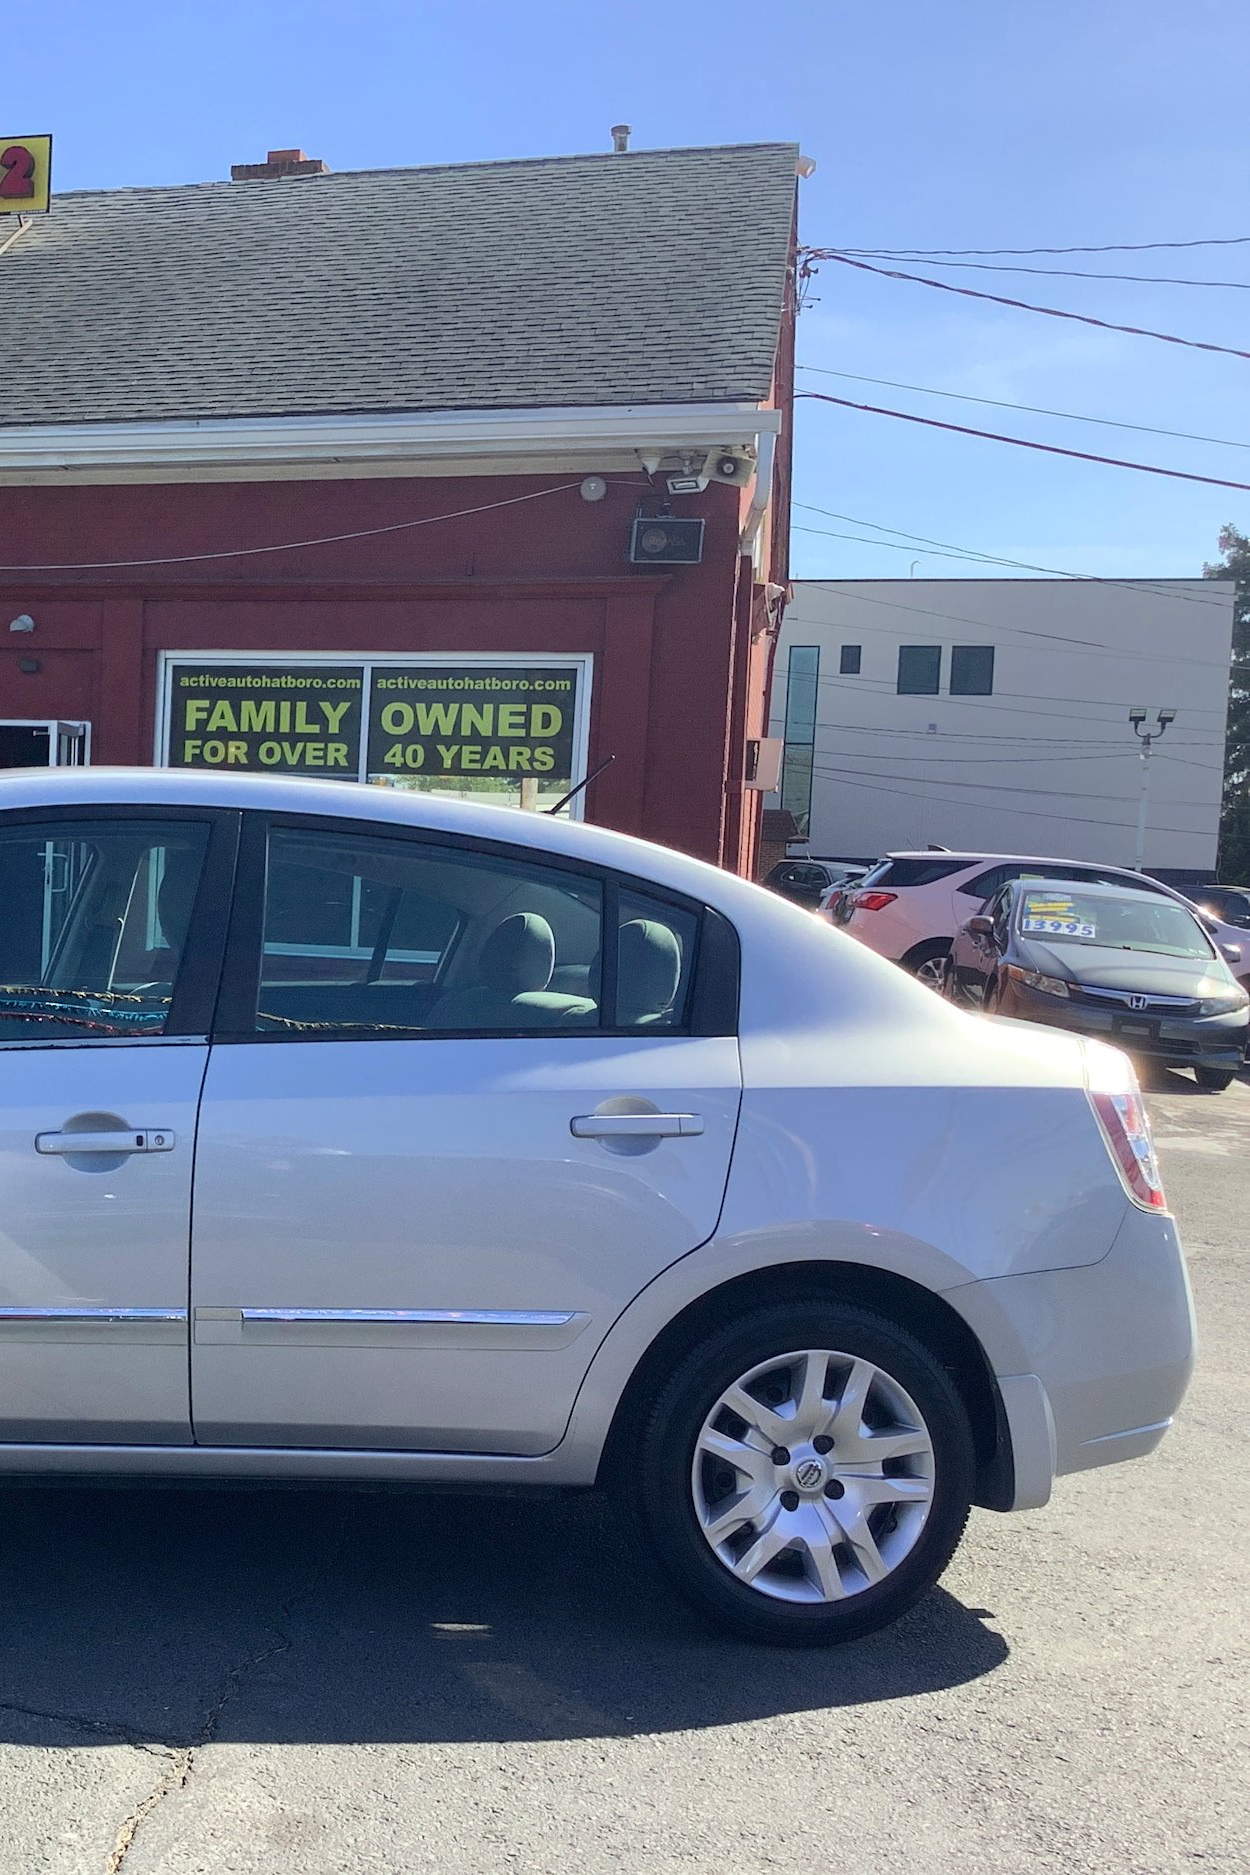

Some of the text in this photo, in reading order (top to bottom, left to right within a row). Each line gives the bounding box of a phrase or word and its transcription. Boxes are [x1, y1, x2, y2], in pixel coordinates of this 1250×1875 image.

[180, 675, 361, 689] activeautohatboro.com
[377, 676, 571, 690] activeautohatboro.com
[185, 700, 351, 734] FAMILY
[381, 702, 562, 737] OWNED
[184, 740, 348, 766] FOR OVER
[384, 743, 555, 771] 40 YEARS
[1024, 920, 1093, 936] 13995
